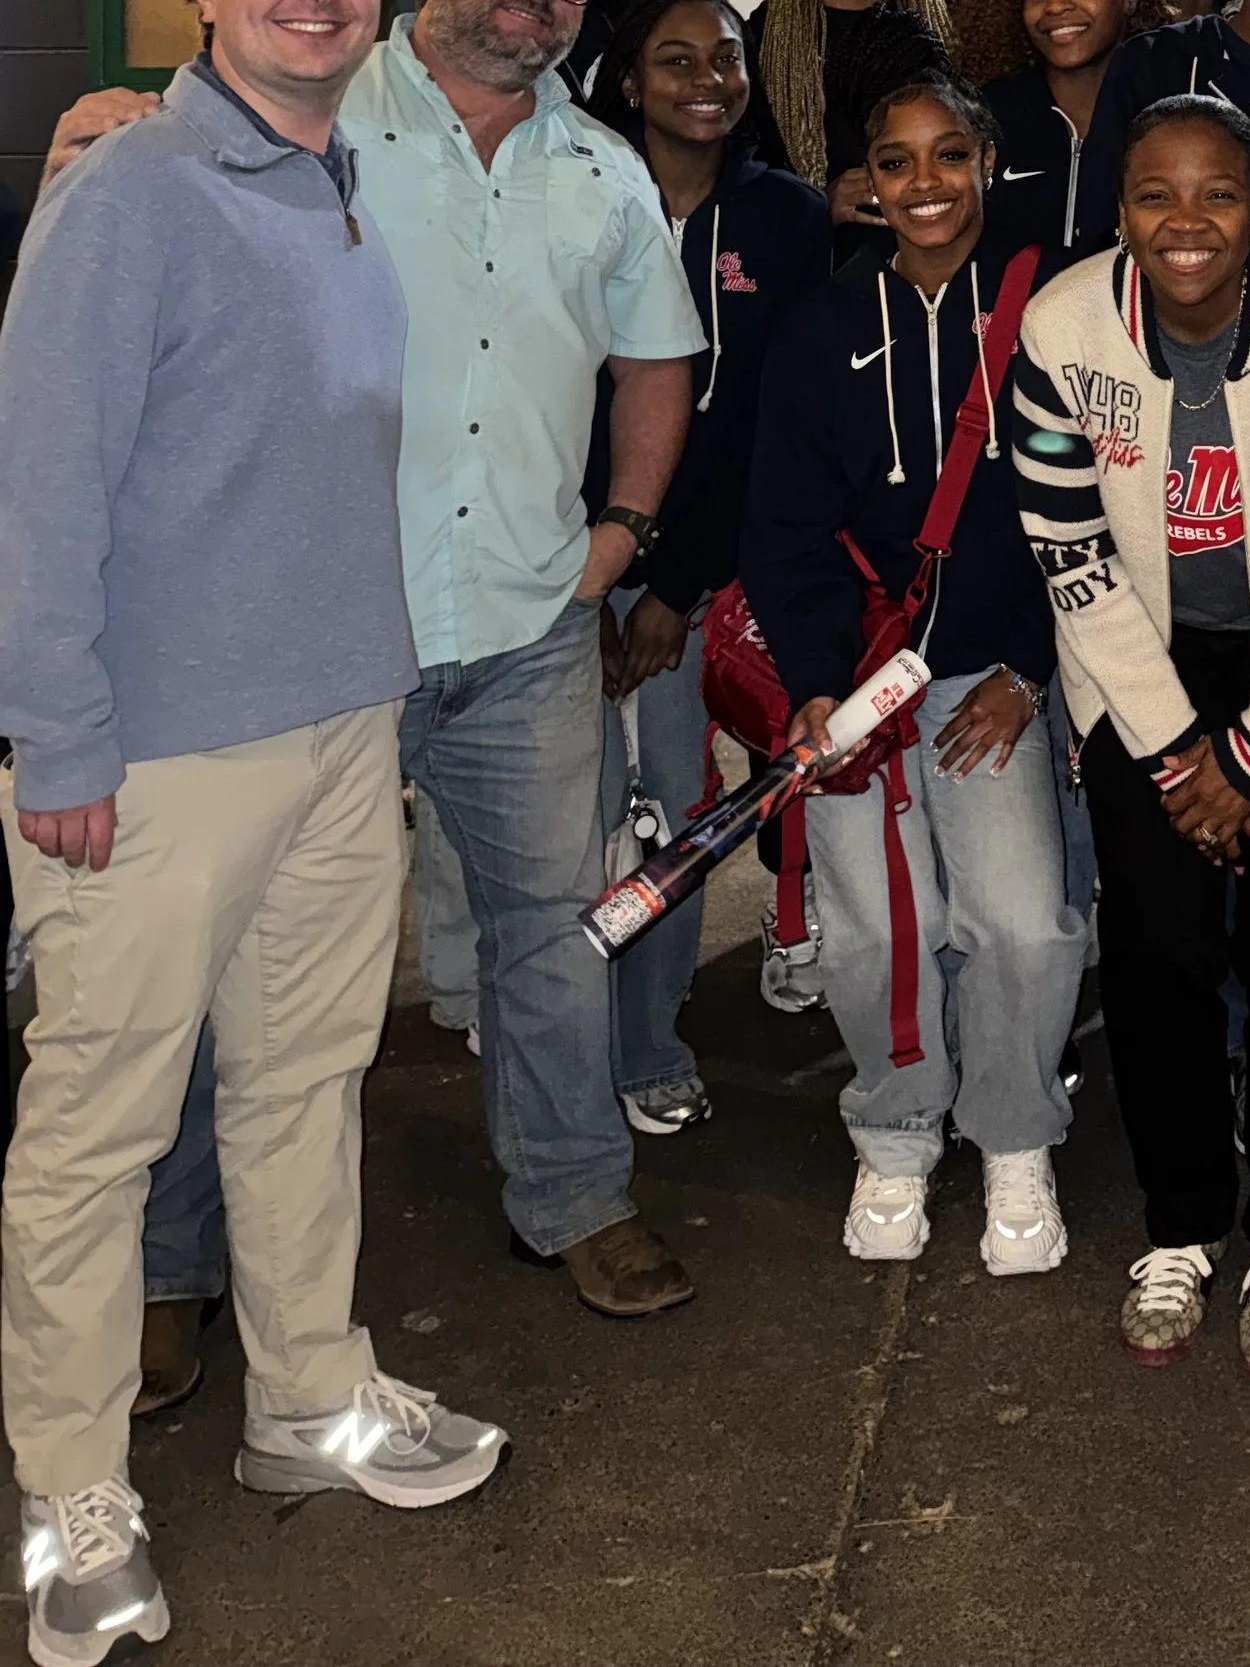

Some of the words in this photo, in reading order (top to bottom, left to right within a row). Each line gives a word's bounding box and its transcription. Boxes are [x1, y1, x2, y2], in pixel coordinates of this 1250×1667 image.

[716, 251, 742, 272] Ole
[721, 270, 758, 292] Miss
[1167, 525, 1227, 541] REBELS
